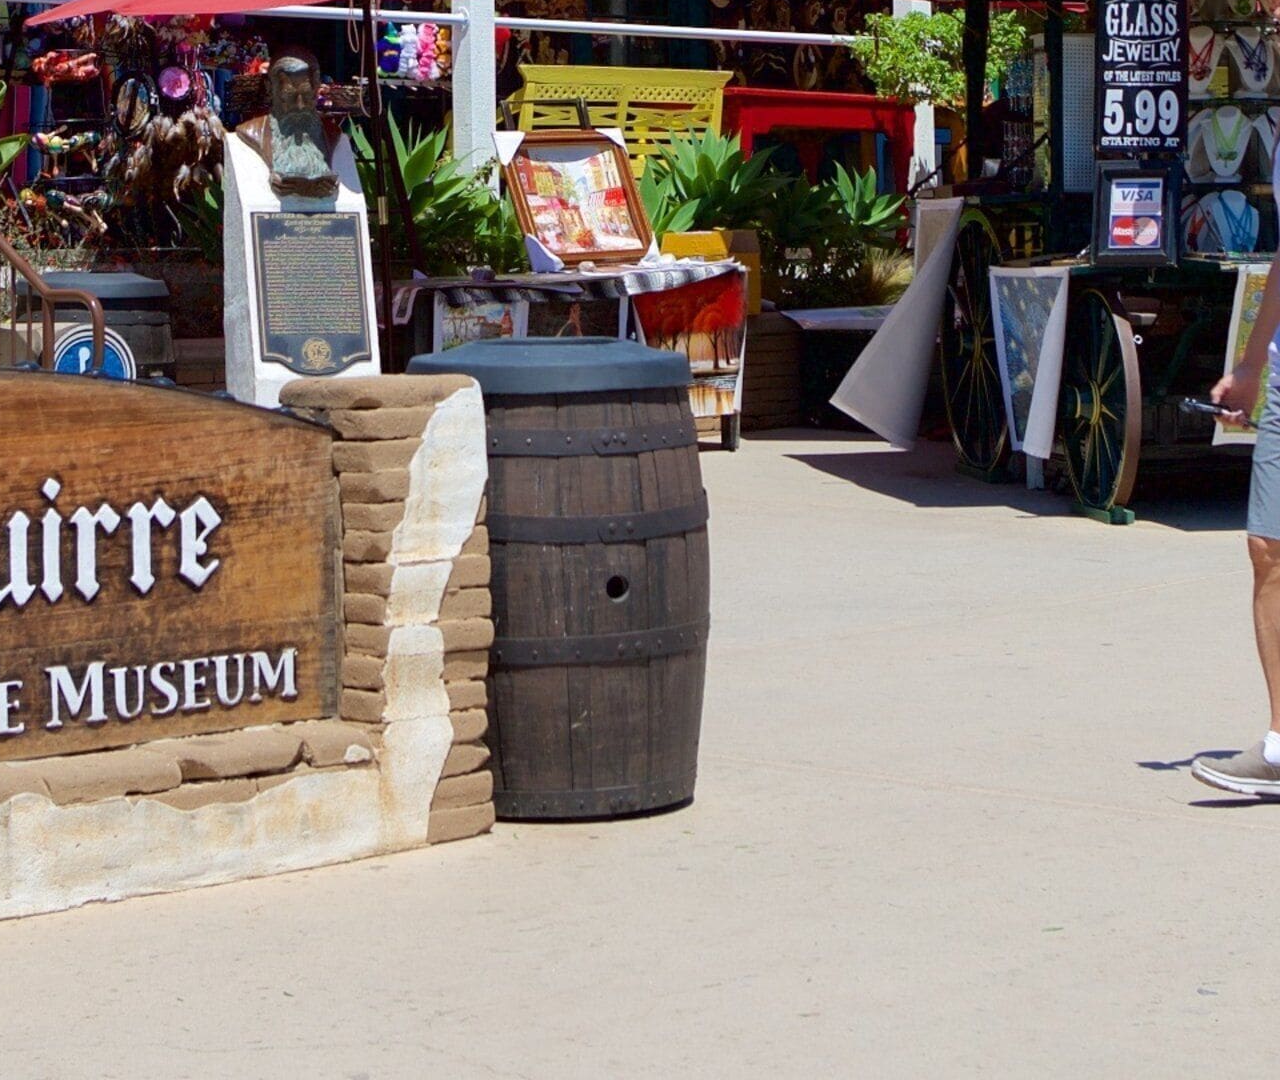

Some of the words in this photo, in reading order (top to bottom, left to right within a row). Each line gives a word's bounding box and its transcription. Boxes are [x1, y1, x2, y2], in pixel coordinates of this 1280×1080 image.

[1103, 70, 1114, 82] OF
[1115, 70, 1129, 82] THE
[1130, 70, 1155, 82] LATEST
[1155, 70, 1182, 82] STYLES
[1102, 88, 1180, 136] 5.99
[1101, 136, 1161, 147] STARTING
[1164, 136, 1180, 147] AT
[1120, 189, 1154, 202] VISA
[45, 647, 298, 730] MUSEUM
